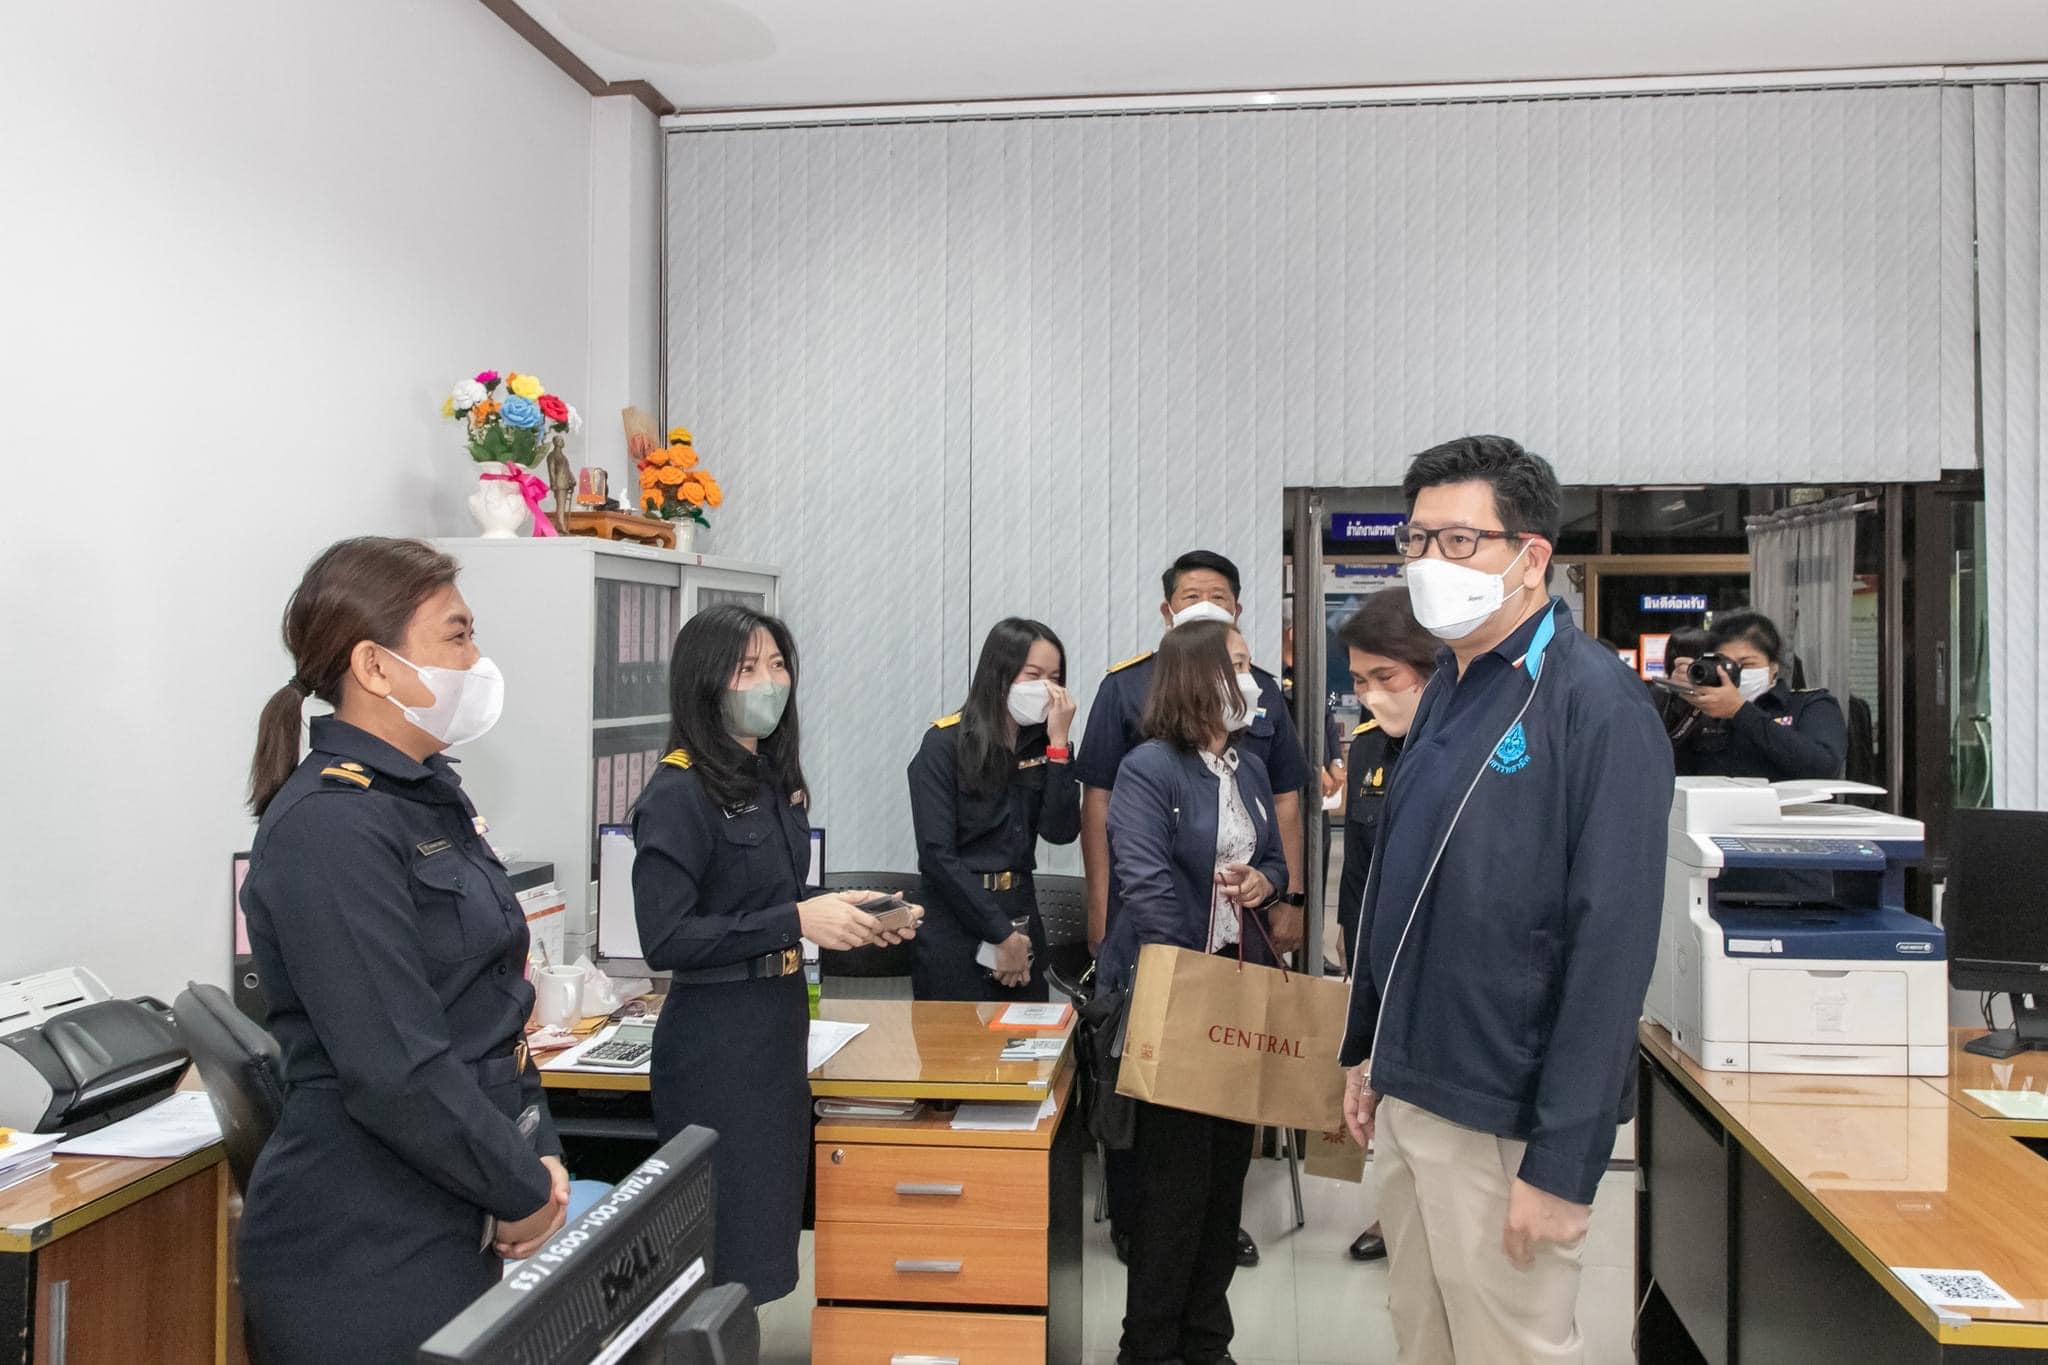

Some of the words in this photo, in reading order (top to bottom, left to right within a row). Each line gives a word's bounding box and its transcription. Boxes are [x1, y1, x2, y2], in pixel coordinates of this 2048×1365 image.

[1644, 595, 1705, 609] ยินดีต้อนรับ
[1208, 1024, 1305, 1059] CENTRAL
